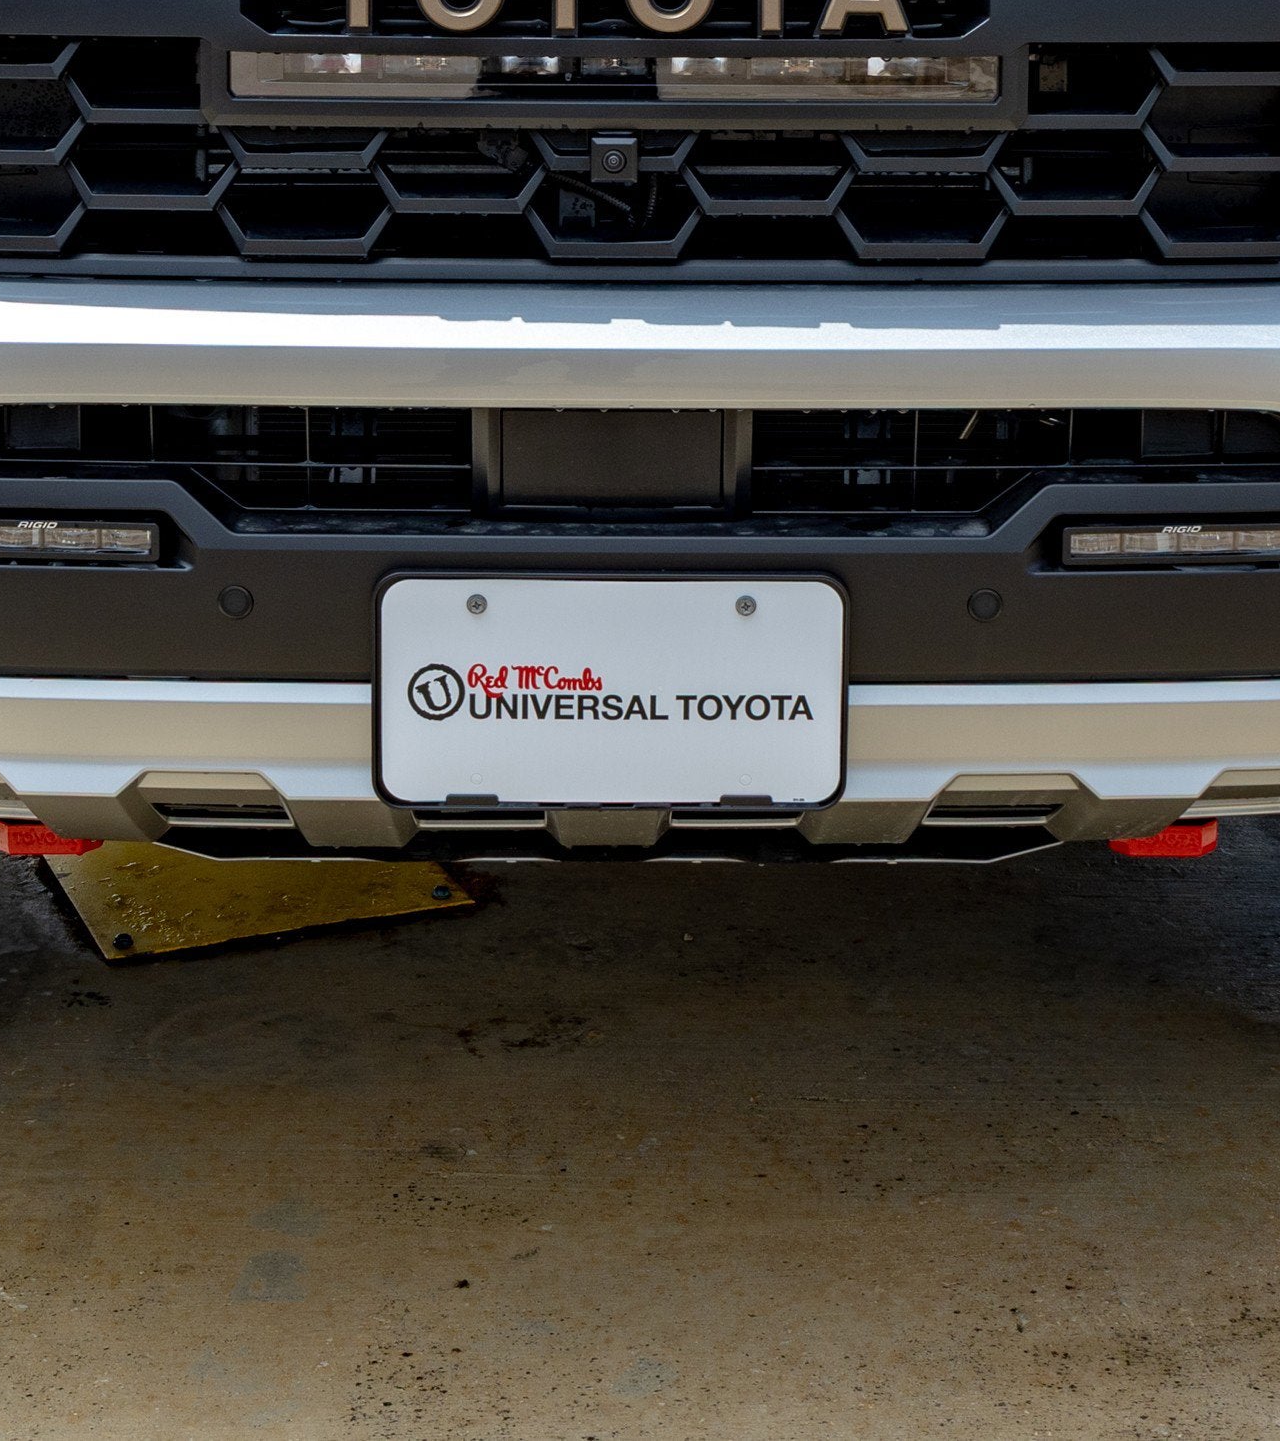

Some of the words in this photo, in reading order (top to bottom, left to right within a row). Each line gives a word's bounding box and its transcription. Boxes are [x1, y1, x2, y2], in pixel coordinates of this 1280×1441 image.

[17, 520, 59, 530] RIGID
[1161, 525, 1203, 535] RIGID
[467, 663, 509, 699] Red
[469, 693, 669, 721] UNIVERSAL
[675, 694, 815, 721] TOYOTA
